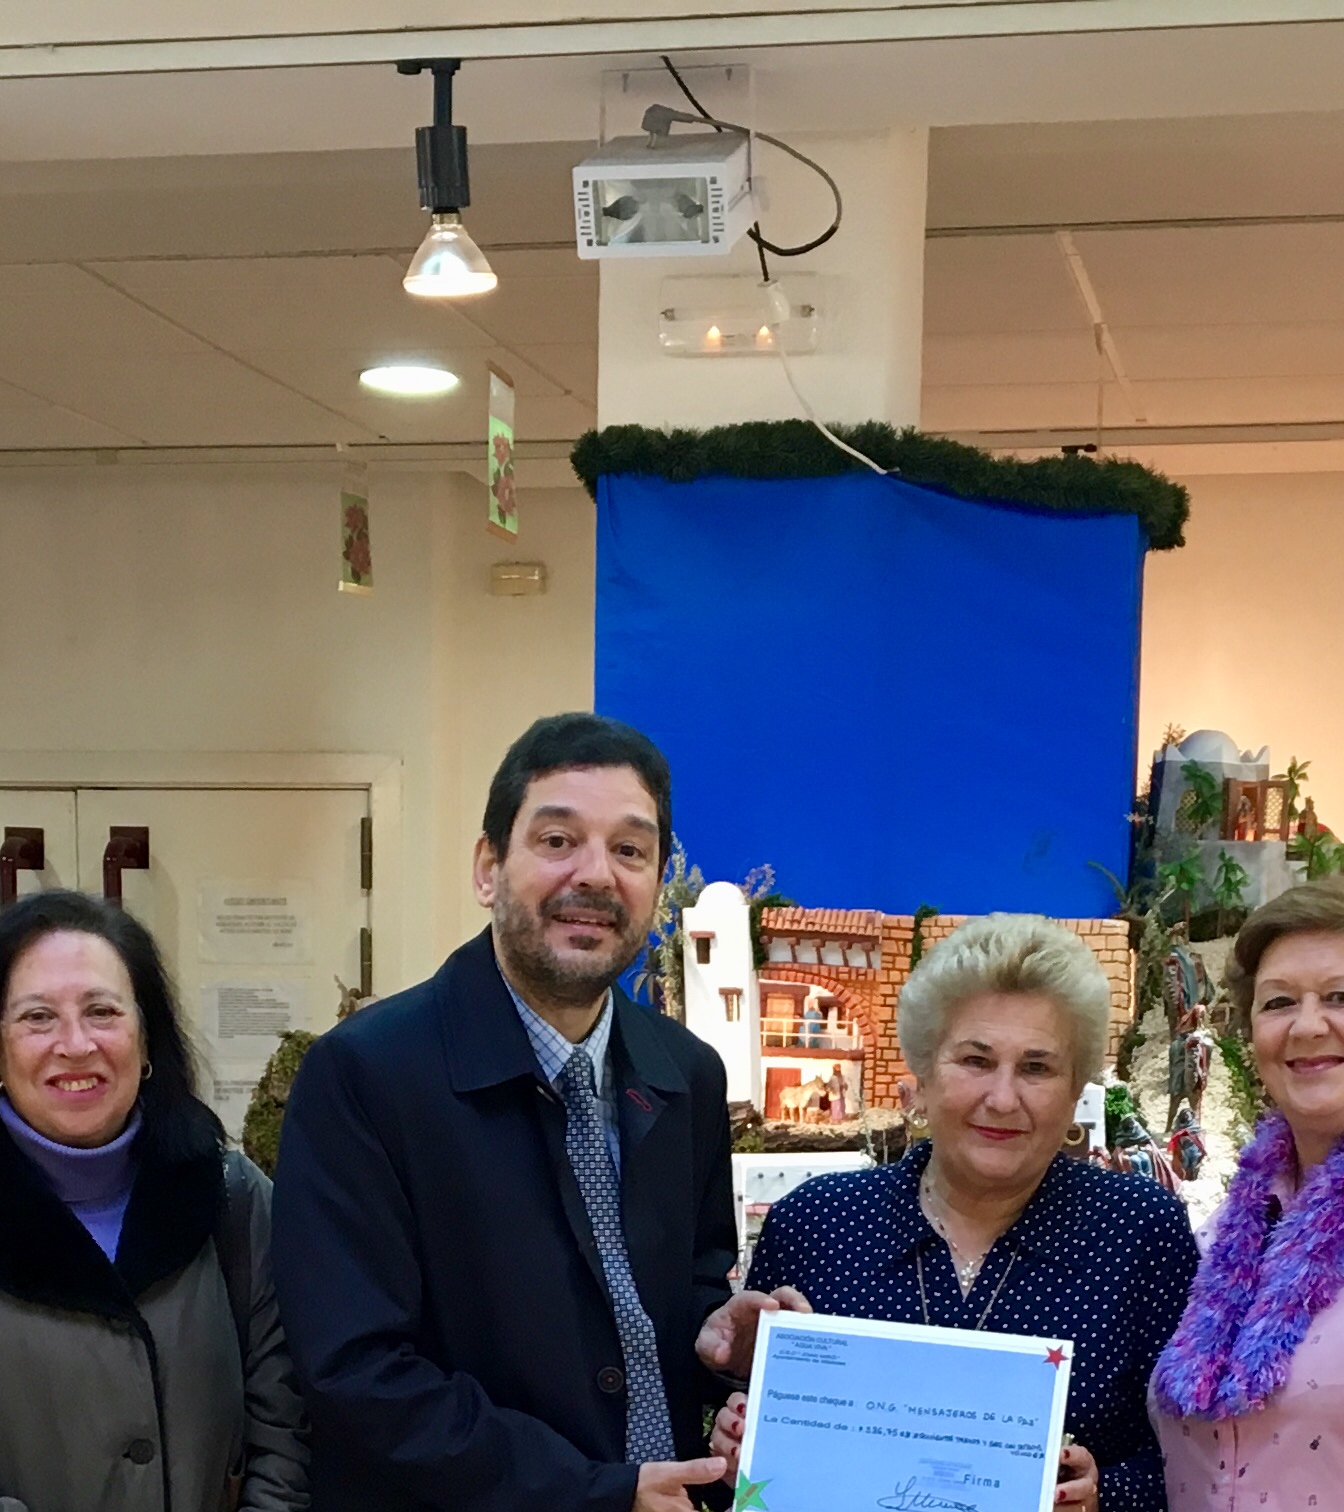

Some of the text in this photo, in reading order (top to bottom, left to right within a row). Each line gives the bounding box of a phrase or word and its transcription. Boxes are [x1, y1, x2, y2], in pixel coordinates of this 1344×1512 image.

[818, 1395, 847, 1408] cheque
[982, 1411, 996, 1421] DE
[1001, 1415, 1014, 1424] LA
[763, 1414, 778, 1423] La
[780, 1416, 832, 1430] Cantidad
[963, 1472, 1001, 1489] Firma
